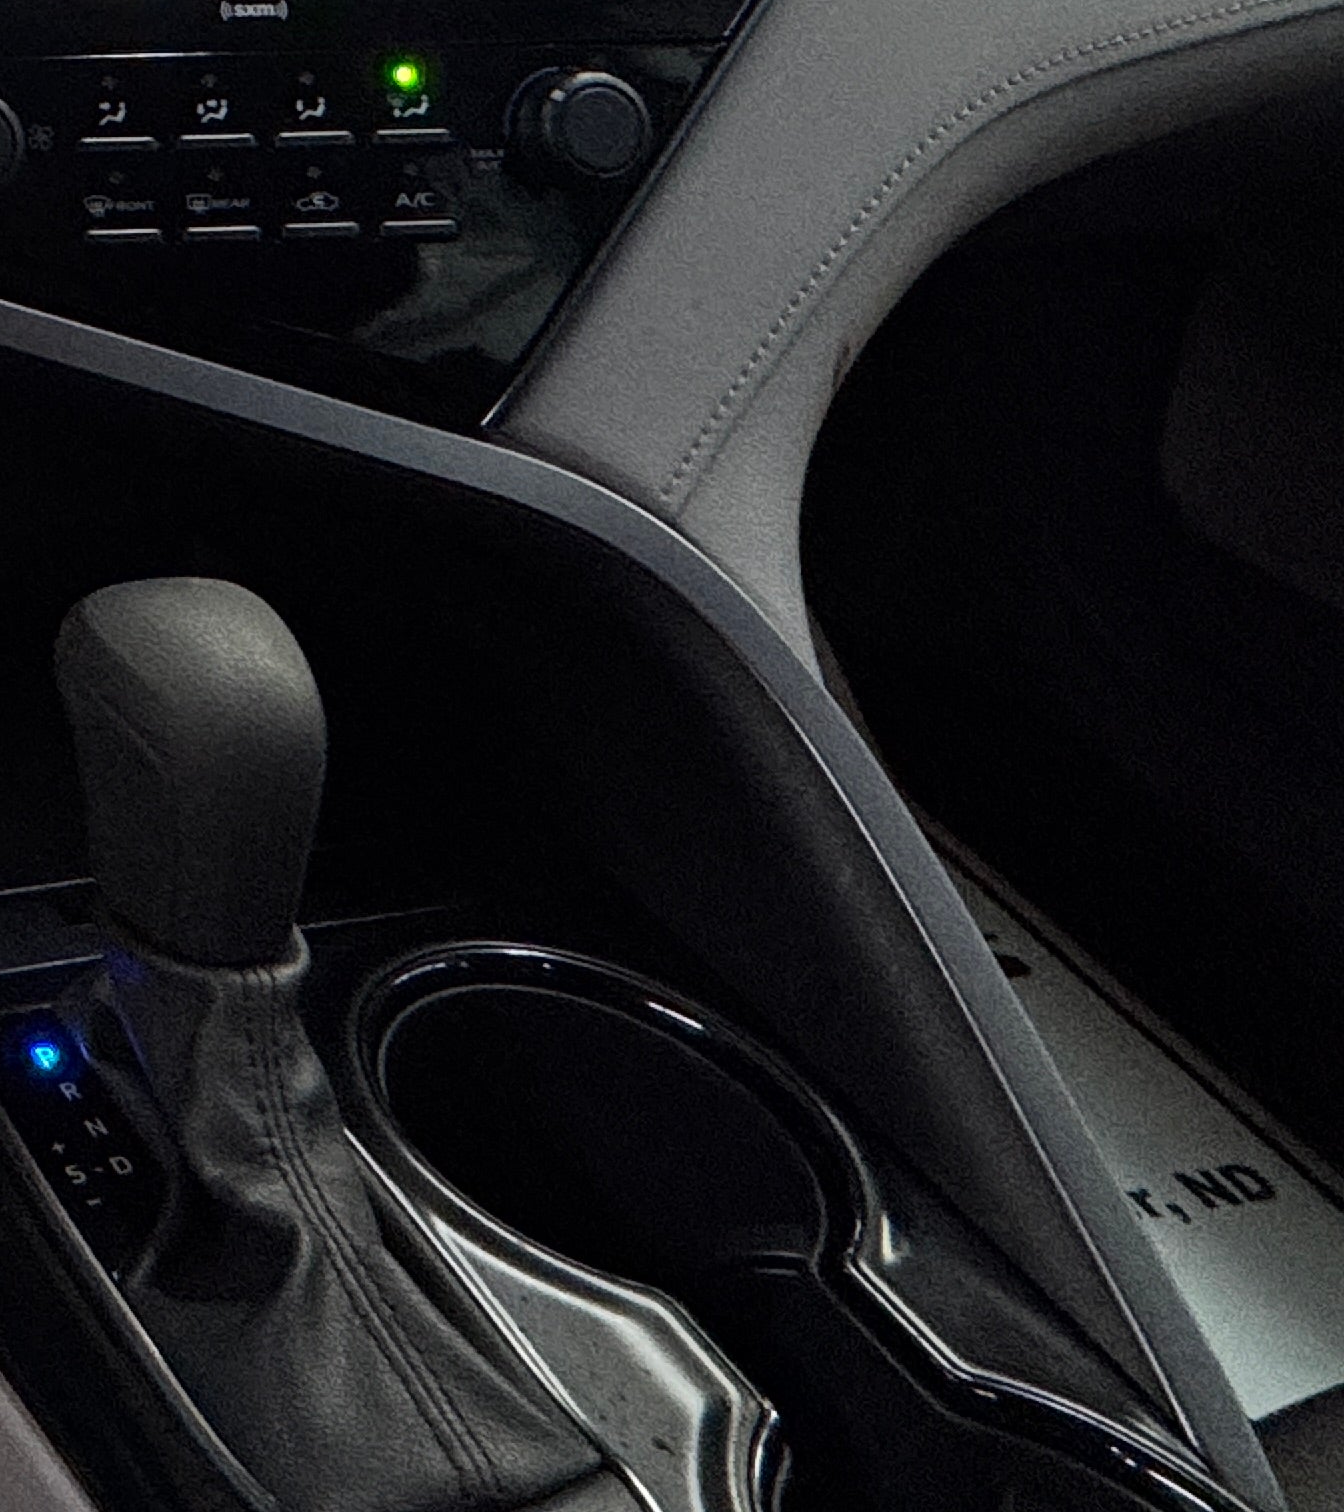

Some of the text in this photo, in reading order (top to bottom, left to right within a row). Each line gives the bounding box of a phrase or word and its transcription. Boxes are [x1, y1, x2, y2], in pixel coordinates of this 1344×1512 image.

[394, 191, 437, 209] A/C
[59, 1081, 83, 1102] R
[82, 1115, 110, 1138] N
[64, 1164, 88, 1186] S
[108, 1155, 134, 1176] D
[1171, 1163, 1276, 1210] ND
